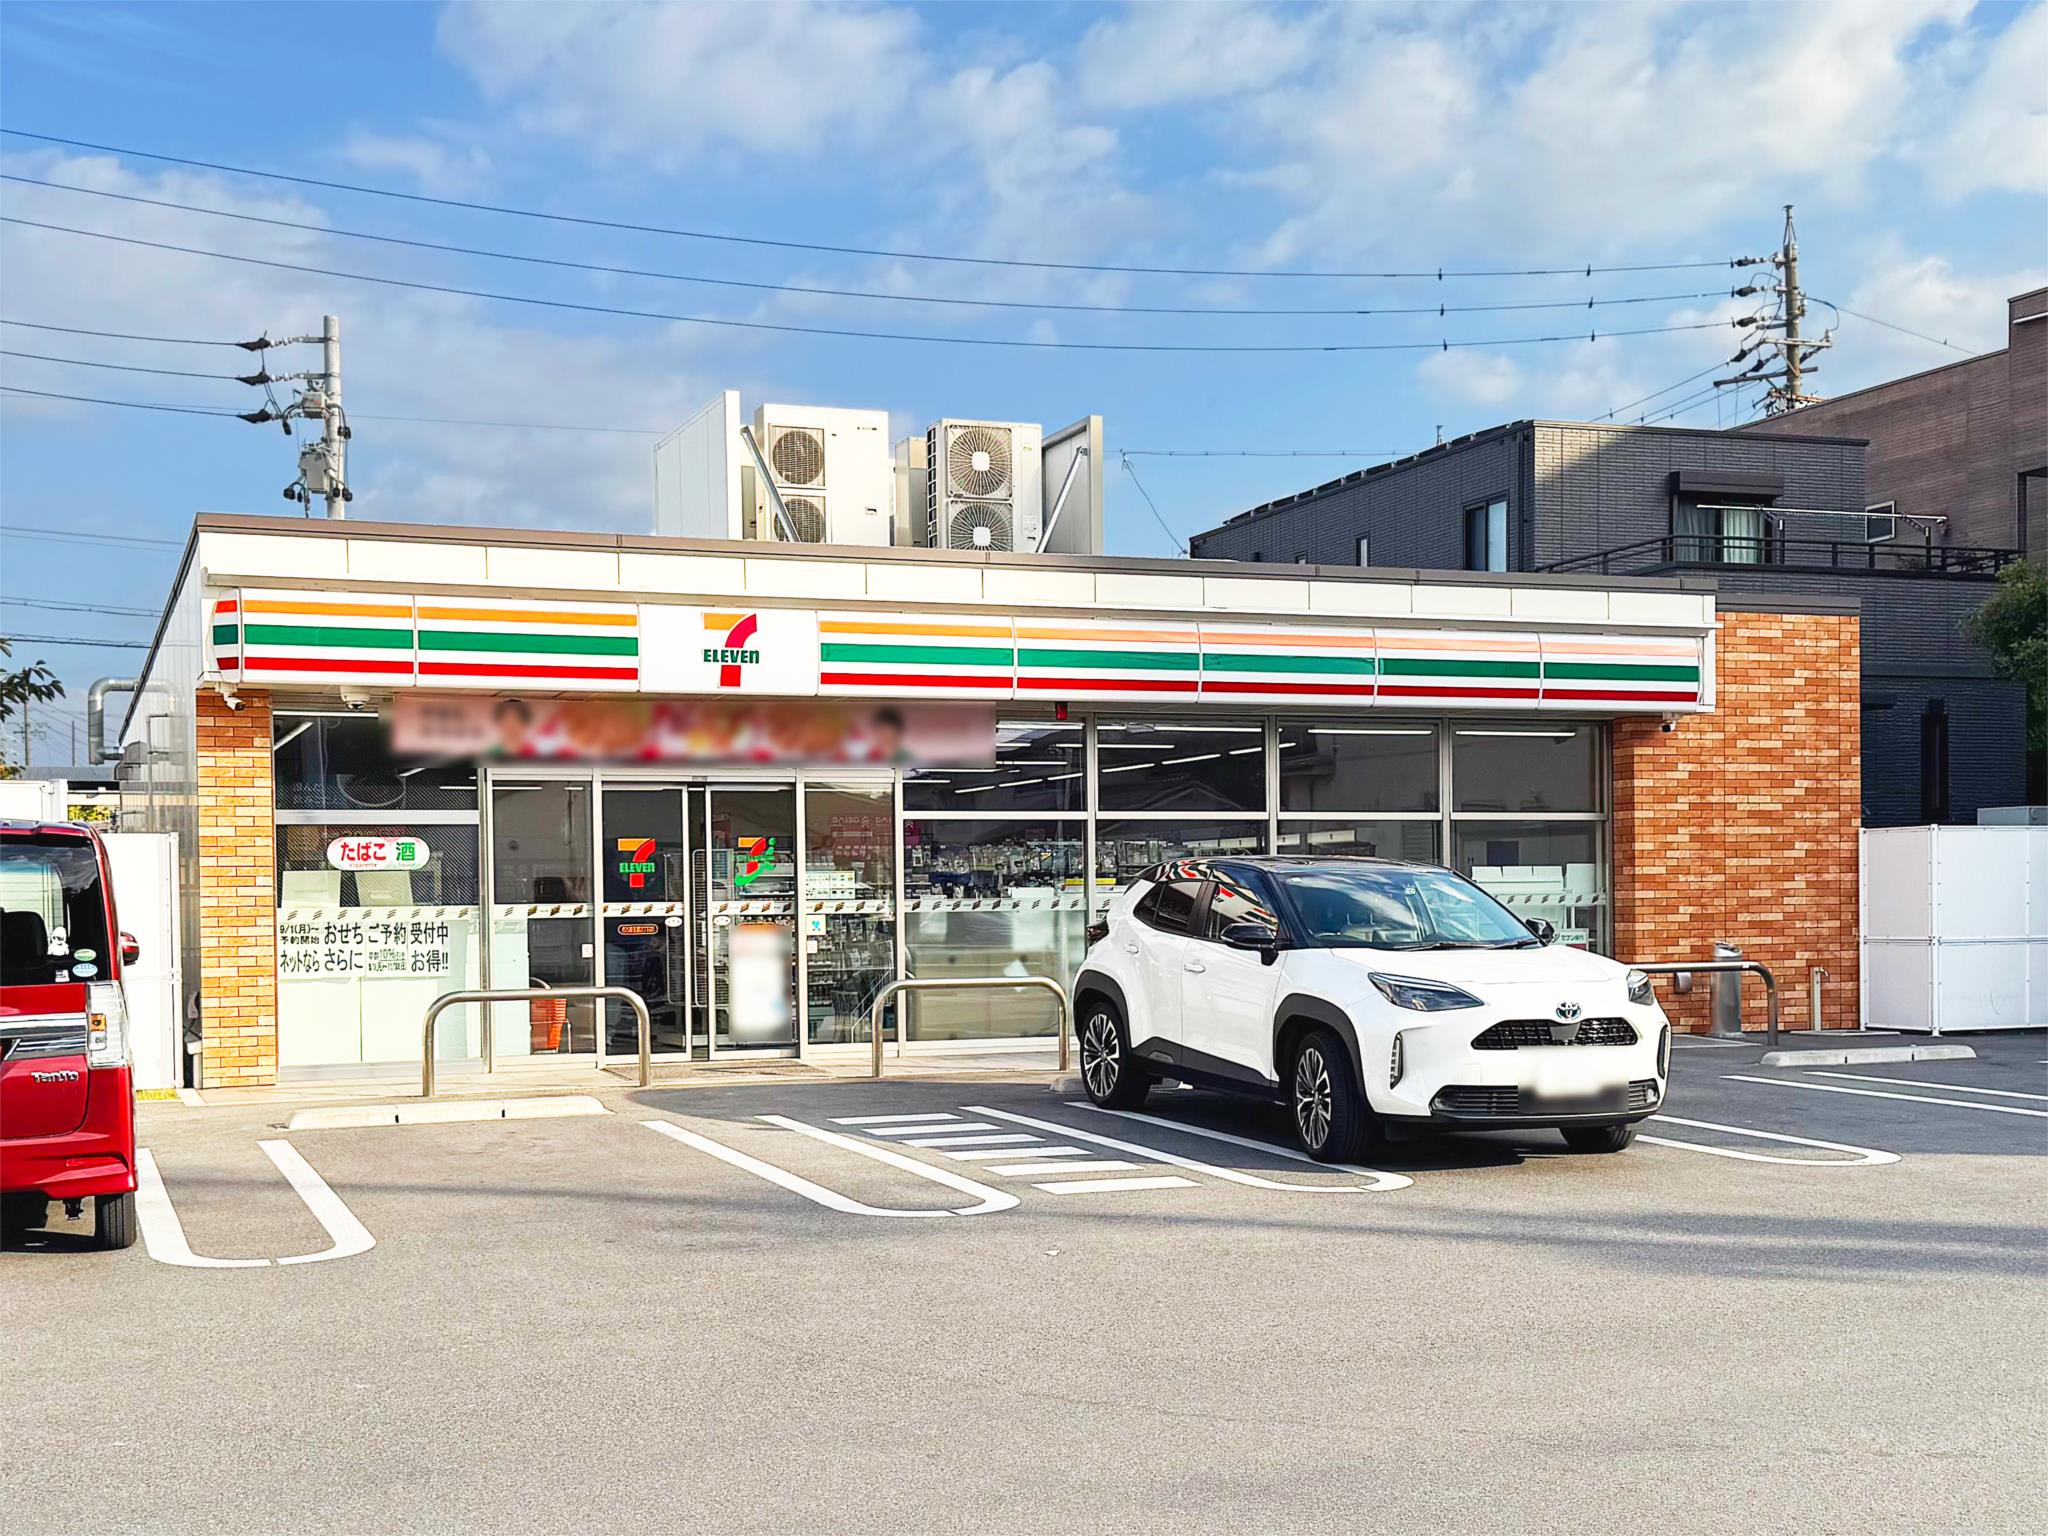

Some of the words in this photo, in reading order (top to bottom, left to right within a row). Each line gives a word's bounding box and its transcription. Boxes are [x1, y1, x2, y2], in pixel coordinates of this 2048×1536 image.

[704, 613, 758, 687] 7
[341, 842, 387, 861] たばこ
[396, 842, 416, 861] 酒
[617, 837, 656, 888] 7
